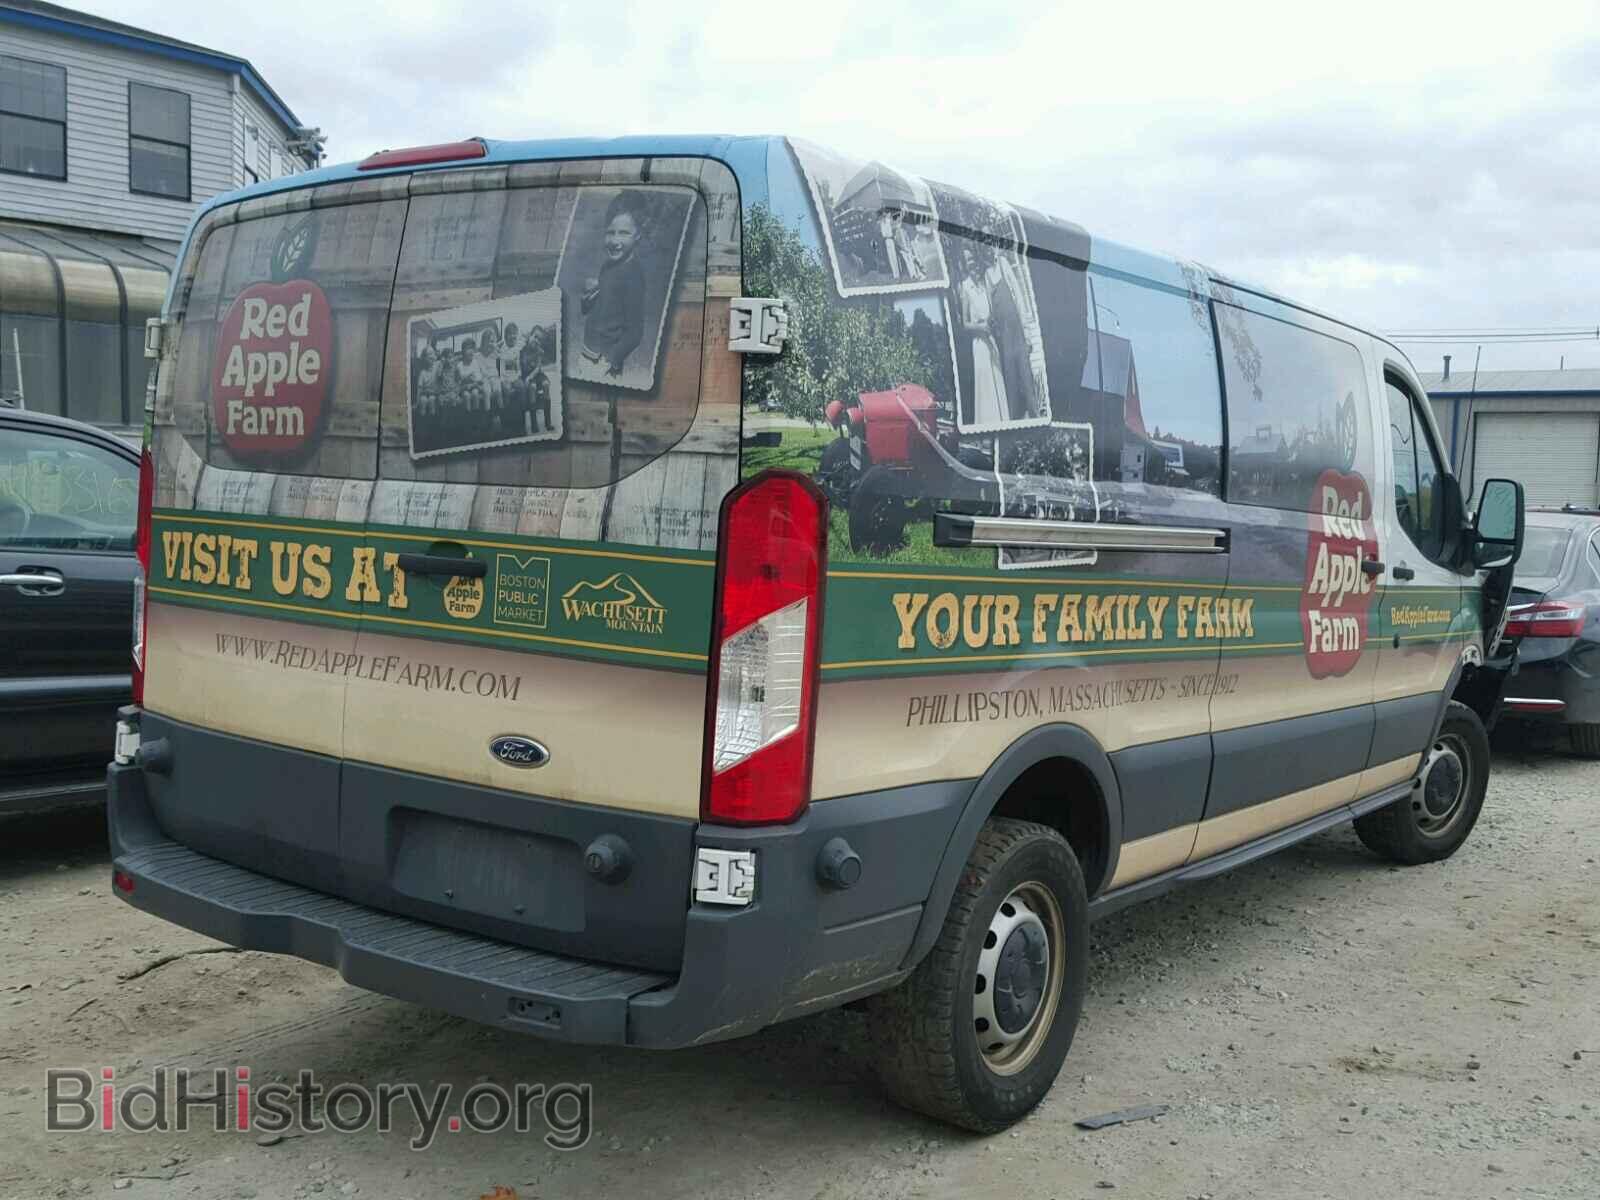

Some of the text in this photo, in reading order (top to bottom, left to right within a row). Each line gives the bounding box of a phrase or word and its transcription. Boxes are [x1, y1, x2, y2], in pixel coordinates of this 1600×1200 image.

[240, 293, 312, 340] Red
[221, 342, 321, 397] Apple
[225, 400, 304, 436] Farm
[1322, 485, 1367, 541] Red
[162, 531, 409, 609] VISIT US AT
[499, 574, 546, 590] BOSTON
[446, 586, 481, 603] Apple
[448, 600, 476, 614] Farm
[498, 589, 540, 606] PUBLIC
[497, 605, 545, 622] MARKET
[561, 598, 669, 624] WACHUSETT
[892, 592, 1255, 649] YOUR FAMILY FARM
[606, 619, 664, 635] MOUNTAIN
[1308, 609, 1360, 654] Farm
[905, 689, 1045, 728] PHILLIPSTON,
[1048, 676, 1167, 713] MASSACHUSETTS
[1177, 673, 1216, 698] SINCE
[500, 741, 532, 761] Ford
